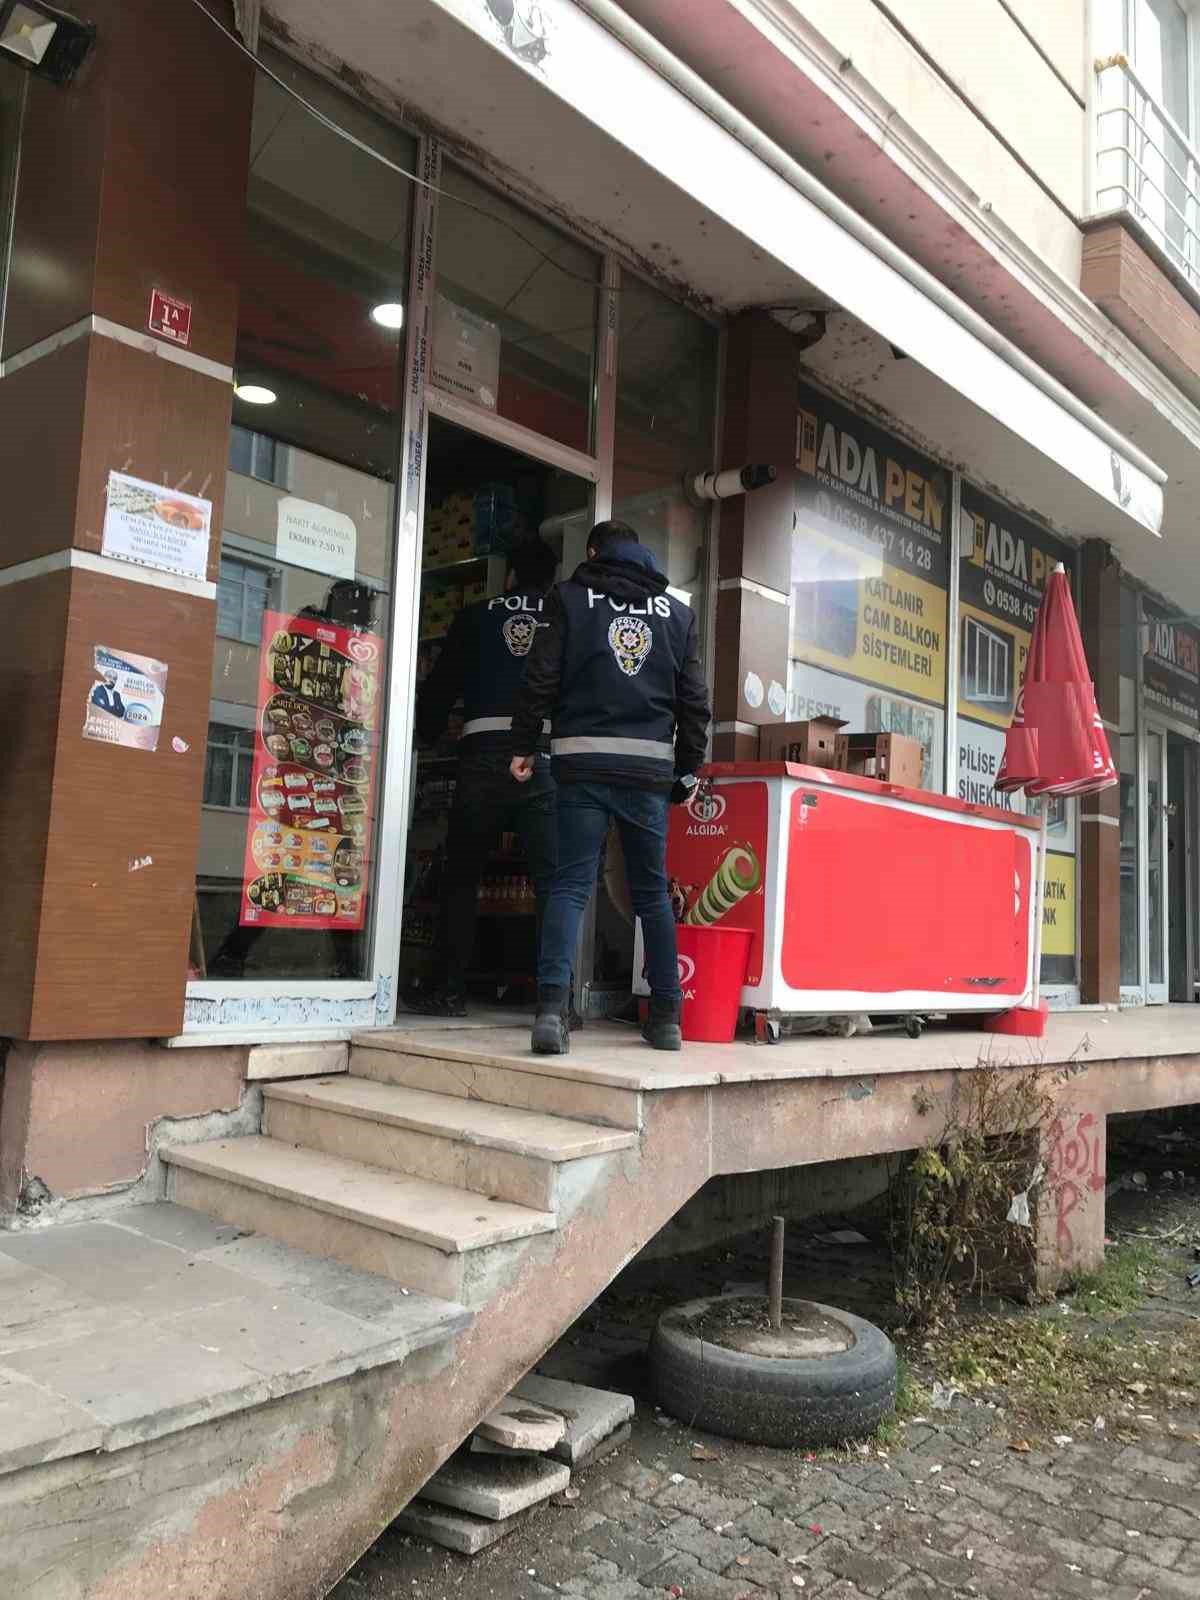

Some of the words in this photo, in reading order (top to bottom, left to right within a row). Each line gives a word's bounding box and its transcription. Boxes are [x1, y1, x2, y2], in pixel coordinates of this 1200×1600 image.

[817, 422, 879, 499] ADA
[884, 458, 944, 531] PEN
[871, 525, 896, 551] 437
[899, 537, 914, 562] 14
[916, 546, 932, 571] 28
[985, 522, 1028, 581] ADA
[488, 595, 544, 612] POLI
[997, 589, 1020, 617] 0538
[863, 606, 891, 632] CAM
[894, 615, 940, 651] BALKON
[862, 632, 932, 678] SİSTEMLERİ
[959, 743, 996, 774] PİLİSE
[686, 824, 725, 836] ALGIDA
